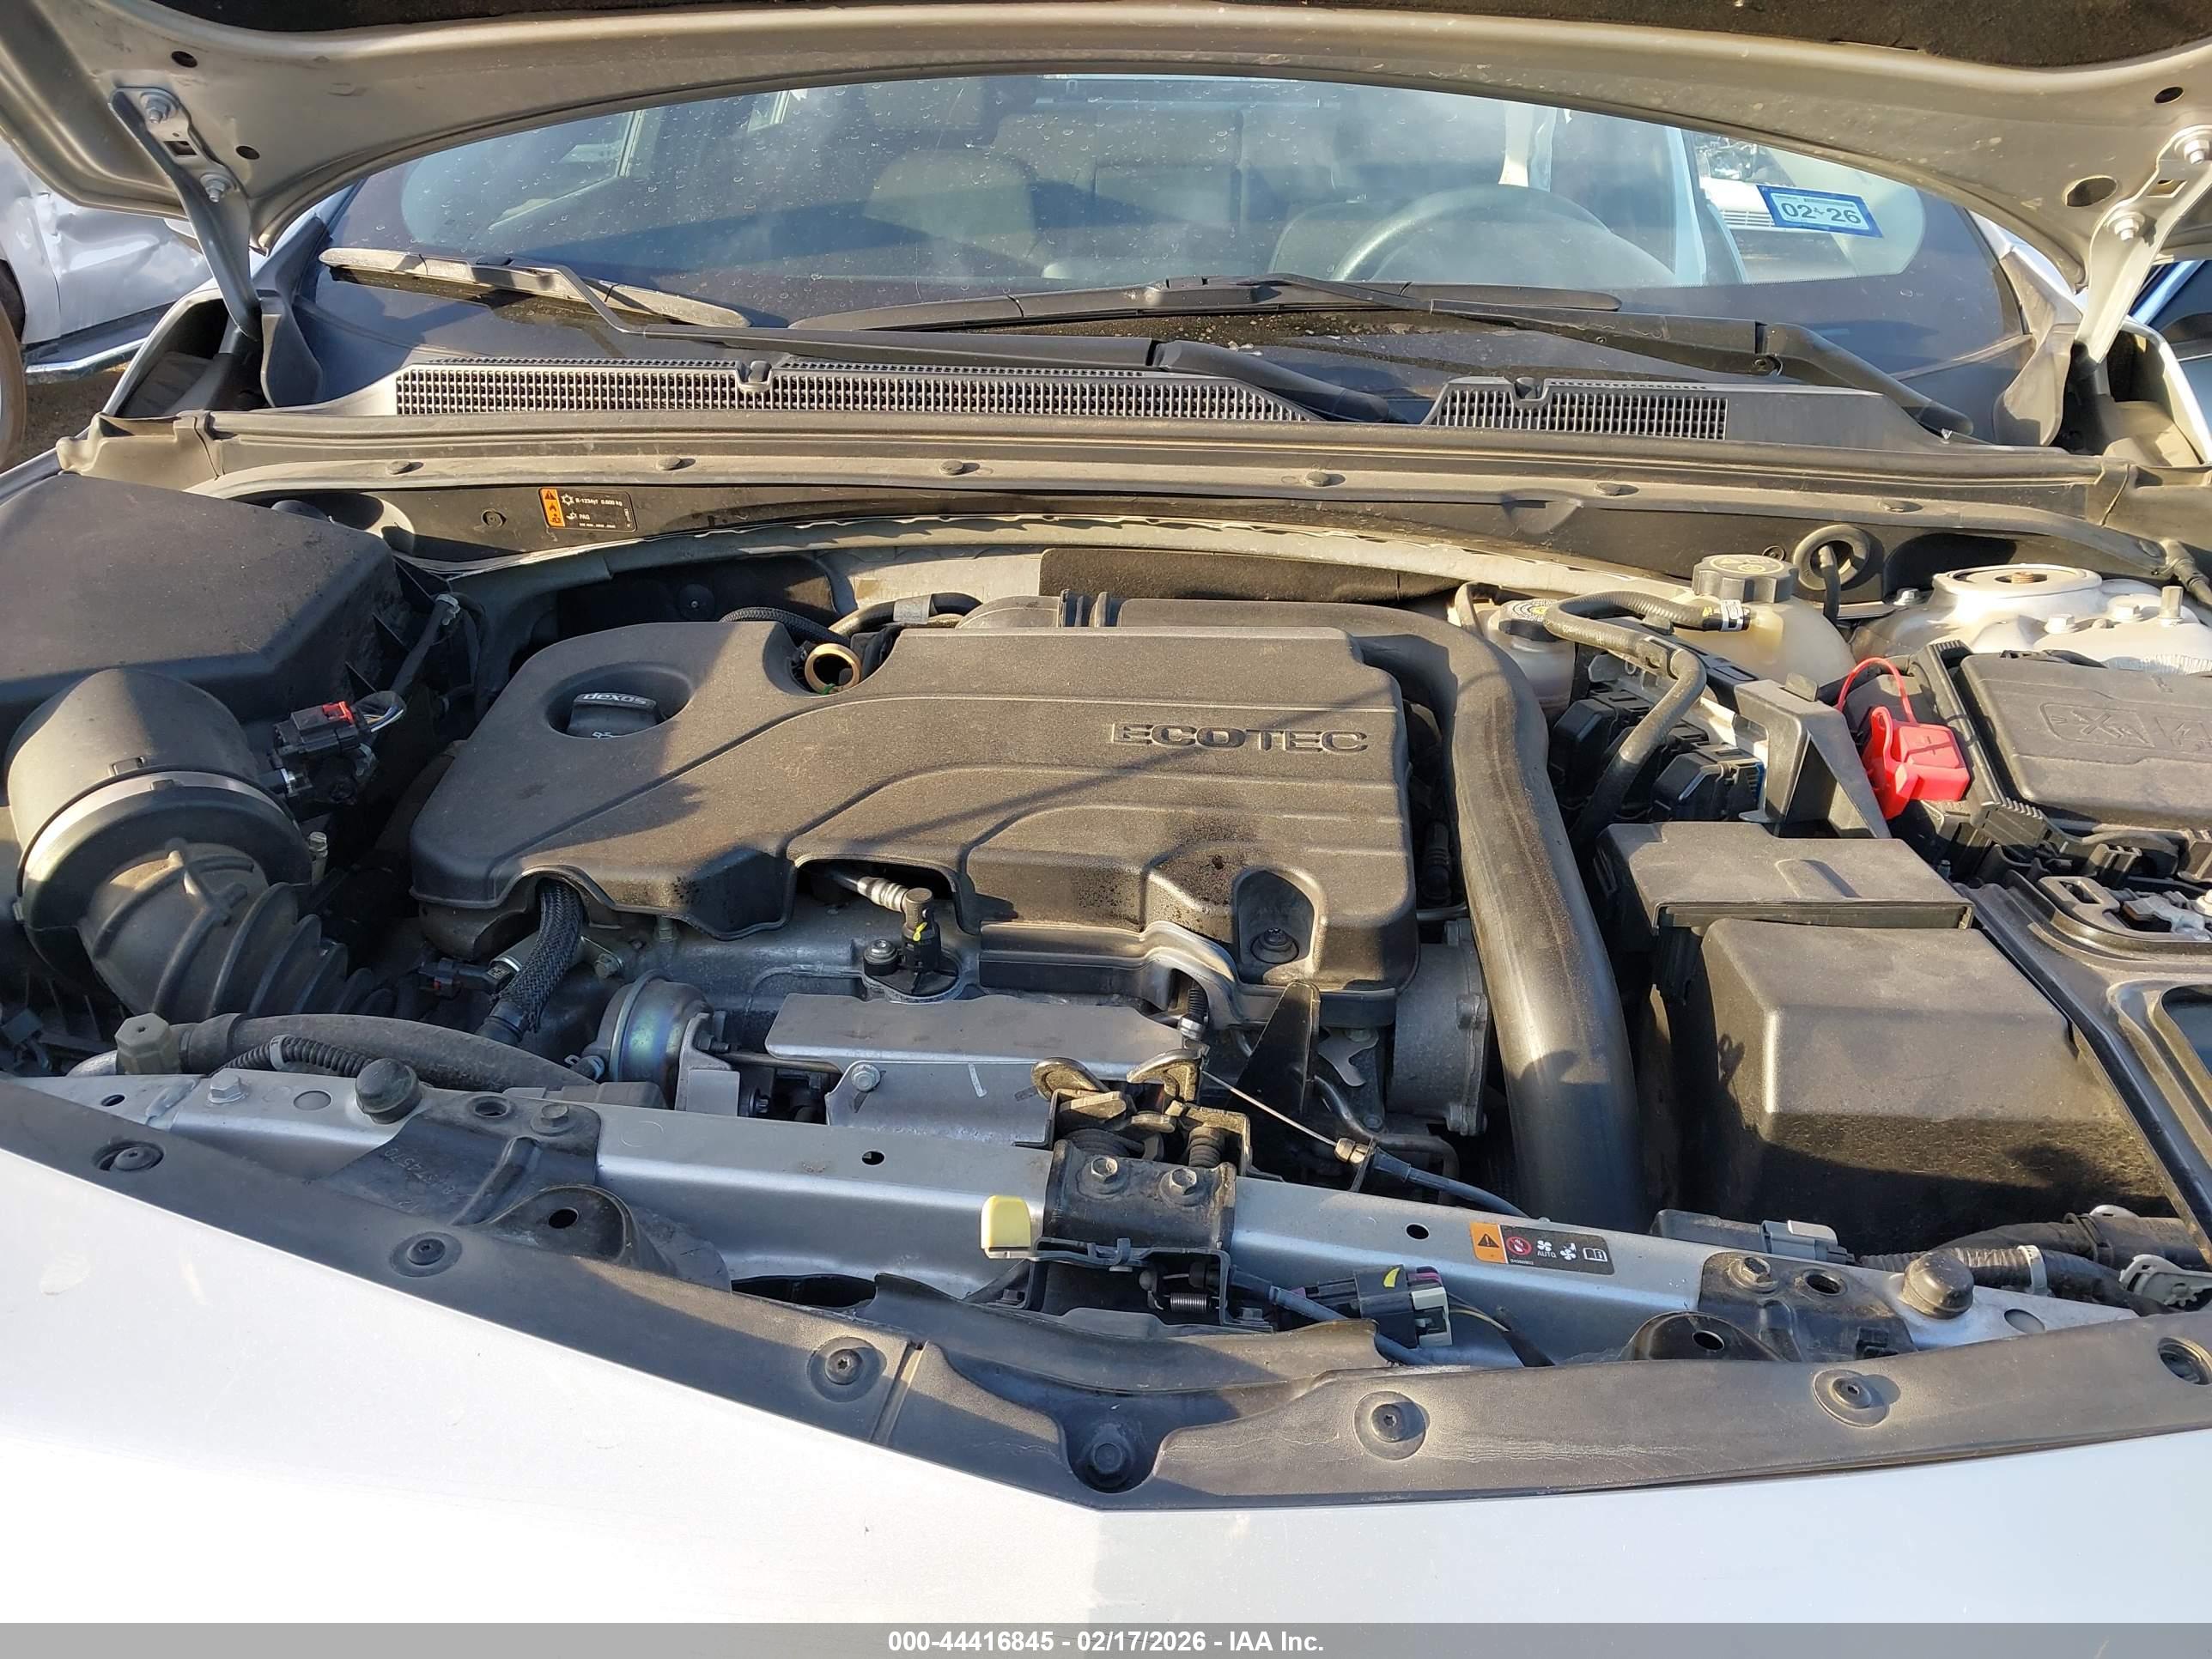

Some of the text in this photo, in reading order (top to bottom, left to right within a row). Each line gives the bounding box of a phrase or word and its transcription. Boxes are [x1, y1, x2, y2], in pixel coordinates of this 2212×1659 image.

[1780, 203, 1862, 224] 02 26
[583, 692, 647, 705] dexos
[1111, 722, 1369, 754] ECOTEC
[1537, 1250, 1557, 1259] AUTO
